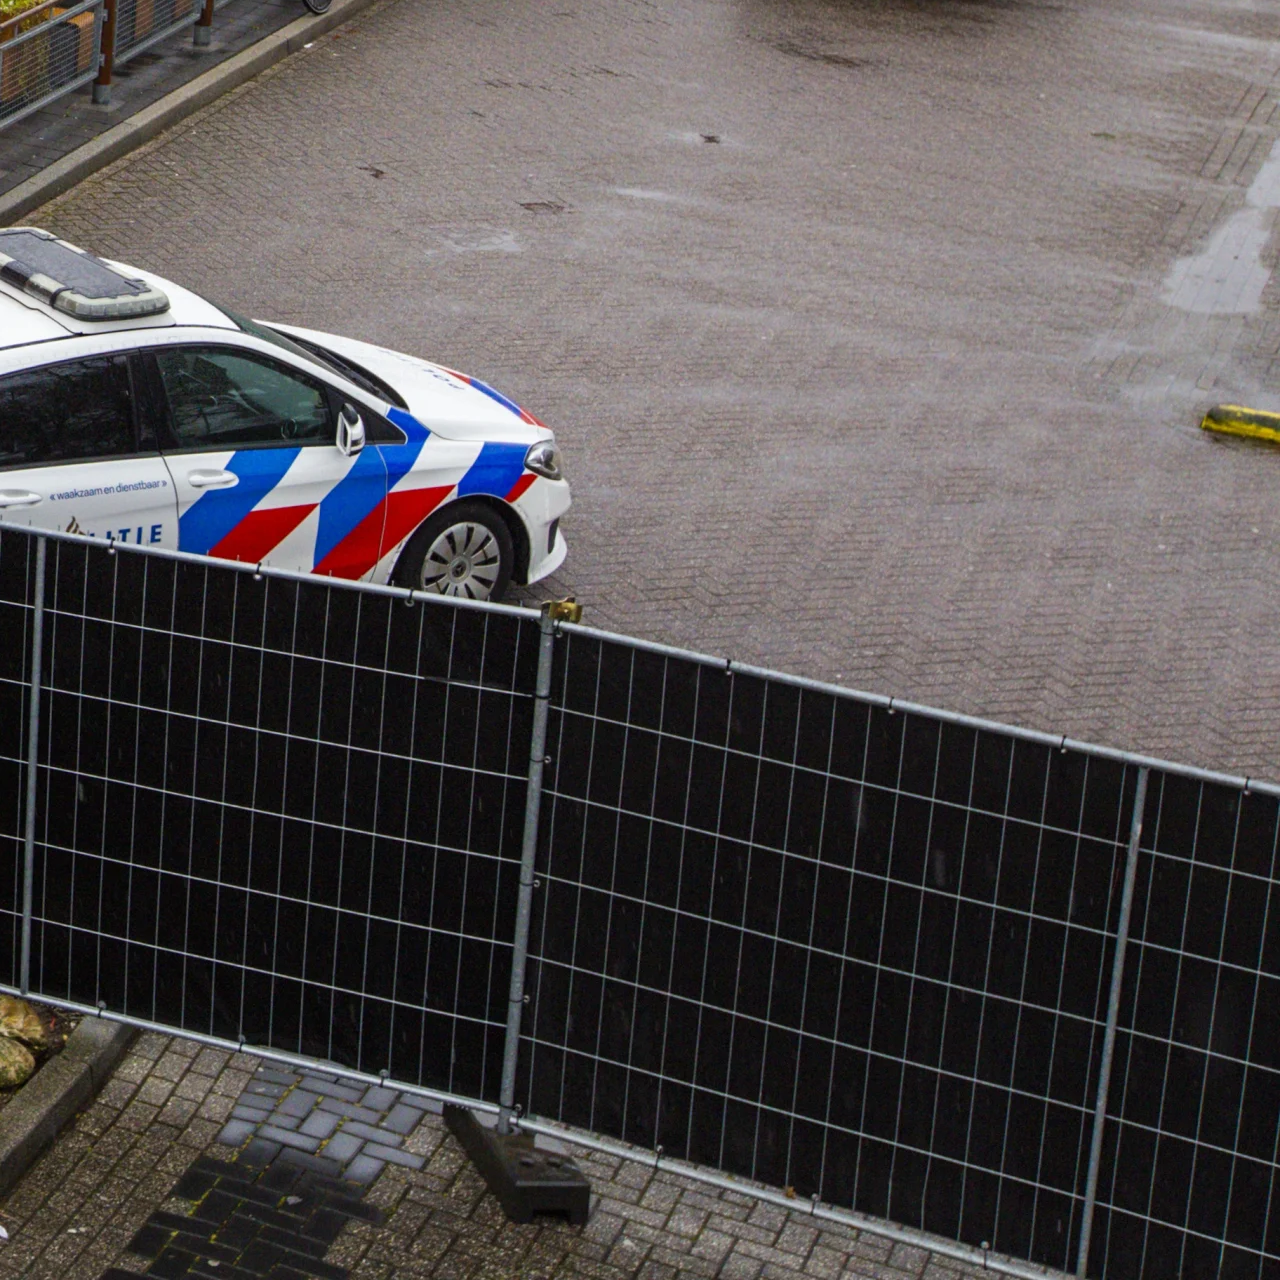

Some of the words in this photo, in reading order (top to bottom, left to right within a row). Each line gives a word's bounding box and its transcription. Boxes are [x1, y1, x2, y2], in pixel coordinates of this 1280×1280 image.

[57, 487, 103, 500] waakzaam
[104, 485, 115, 495] en
[116, 480, 160, 493] dienstbaar
